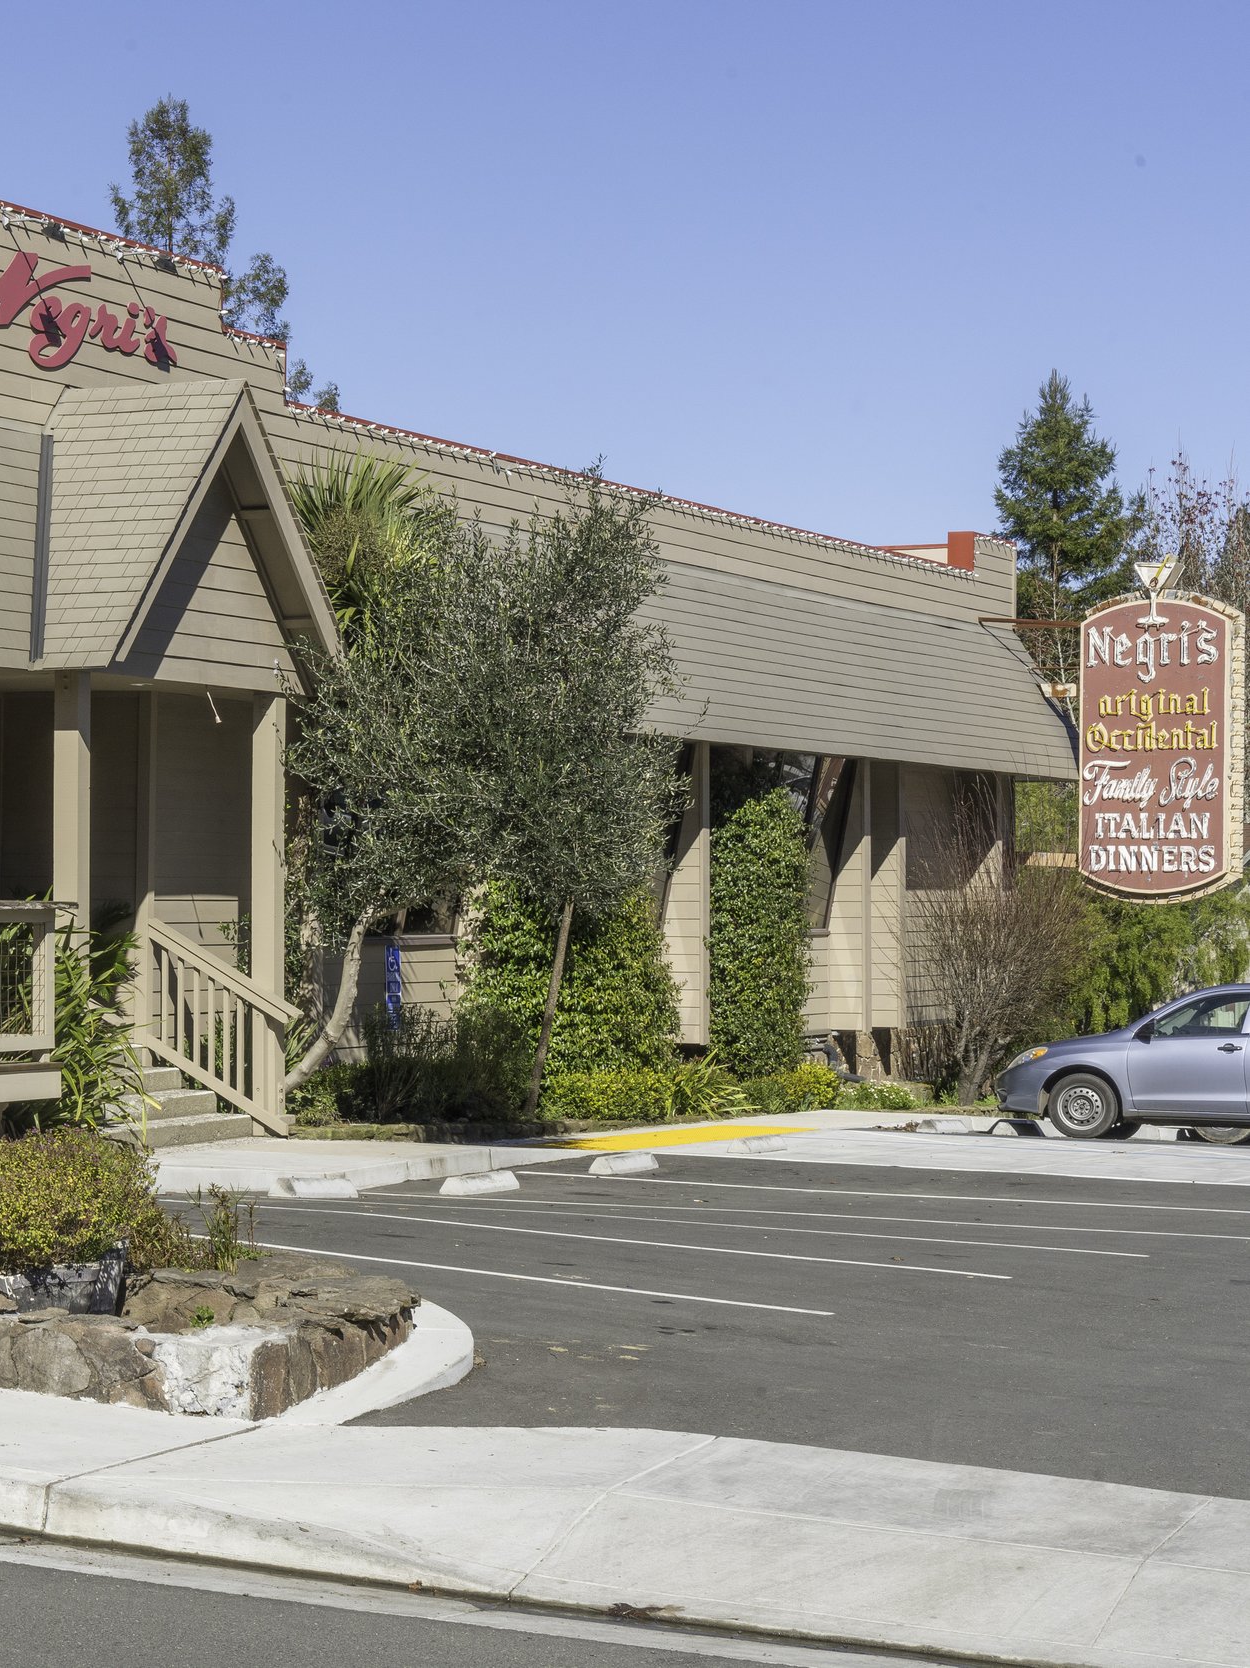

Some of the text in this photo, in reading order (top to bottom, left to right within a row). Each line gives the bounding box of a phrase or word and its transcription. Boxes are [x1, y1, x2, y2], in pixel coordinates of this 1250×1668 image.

[1086, 619, 1219, 684] Negri's
[1098, 686, 1211, 722] original
[1086, 719, 1218, 753] Occidental
[1082, 756, 1220, 812] Family Style
[1094, 812, 1211, 840] ITALIAN
[1088, 844, 1215, 874] DINNERS
